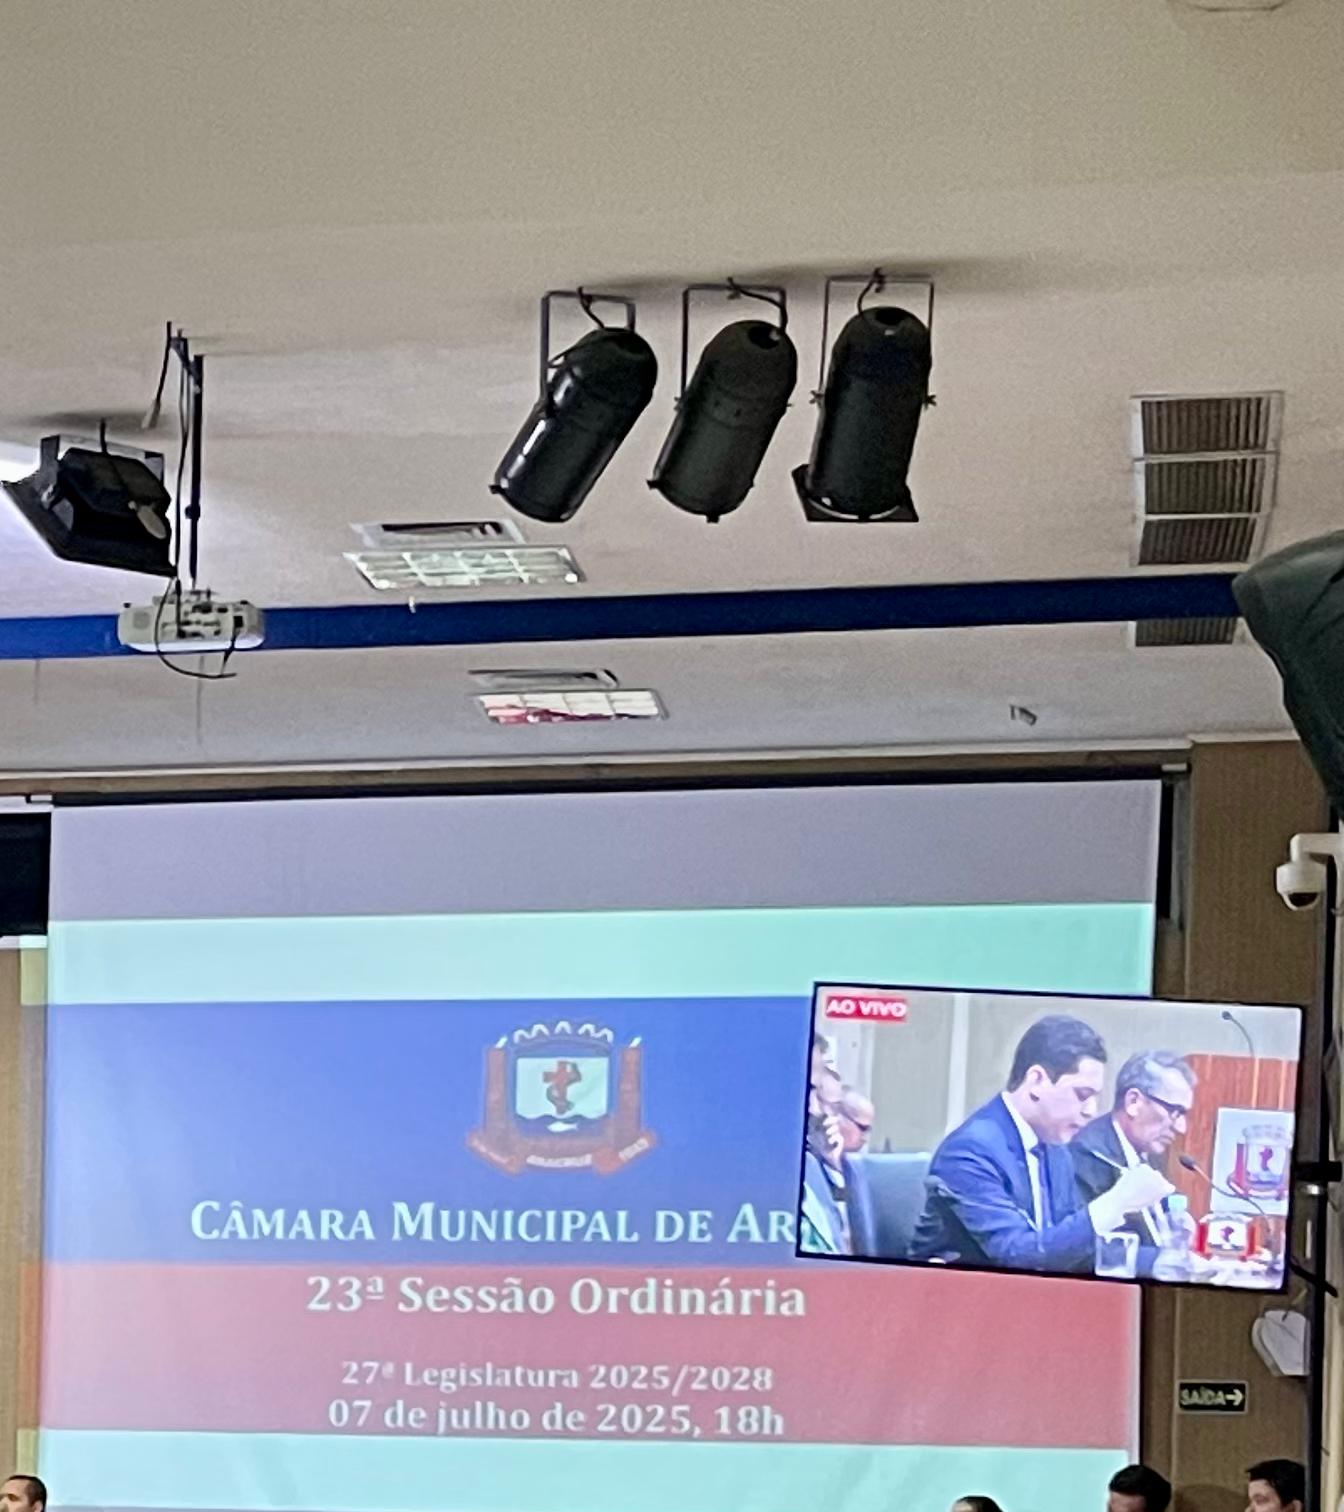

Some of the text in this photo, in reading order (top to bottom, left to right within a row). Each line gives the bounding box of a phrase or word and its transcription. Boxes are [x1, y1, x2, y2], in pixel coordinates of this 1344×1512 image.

[827, 999, 907, 1017] AO VIVO
[191, 1200, 376, 1240] CÂMARA
[391, 1201, 639, 1243] MUNICIPAL
[655, 1209, 712, 1243] DE
[306, 1275, 806, 1316] 23ª Sessão Ordinária
[404, 1361, 579, 1393] Legislatura
[588, 1364, 773, 1397] 2025/2028
[1180, 1387, 1226, 1406] SAÍDA
[328, 1399, 784, 1438] 07 de julho de 2025, 18h
